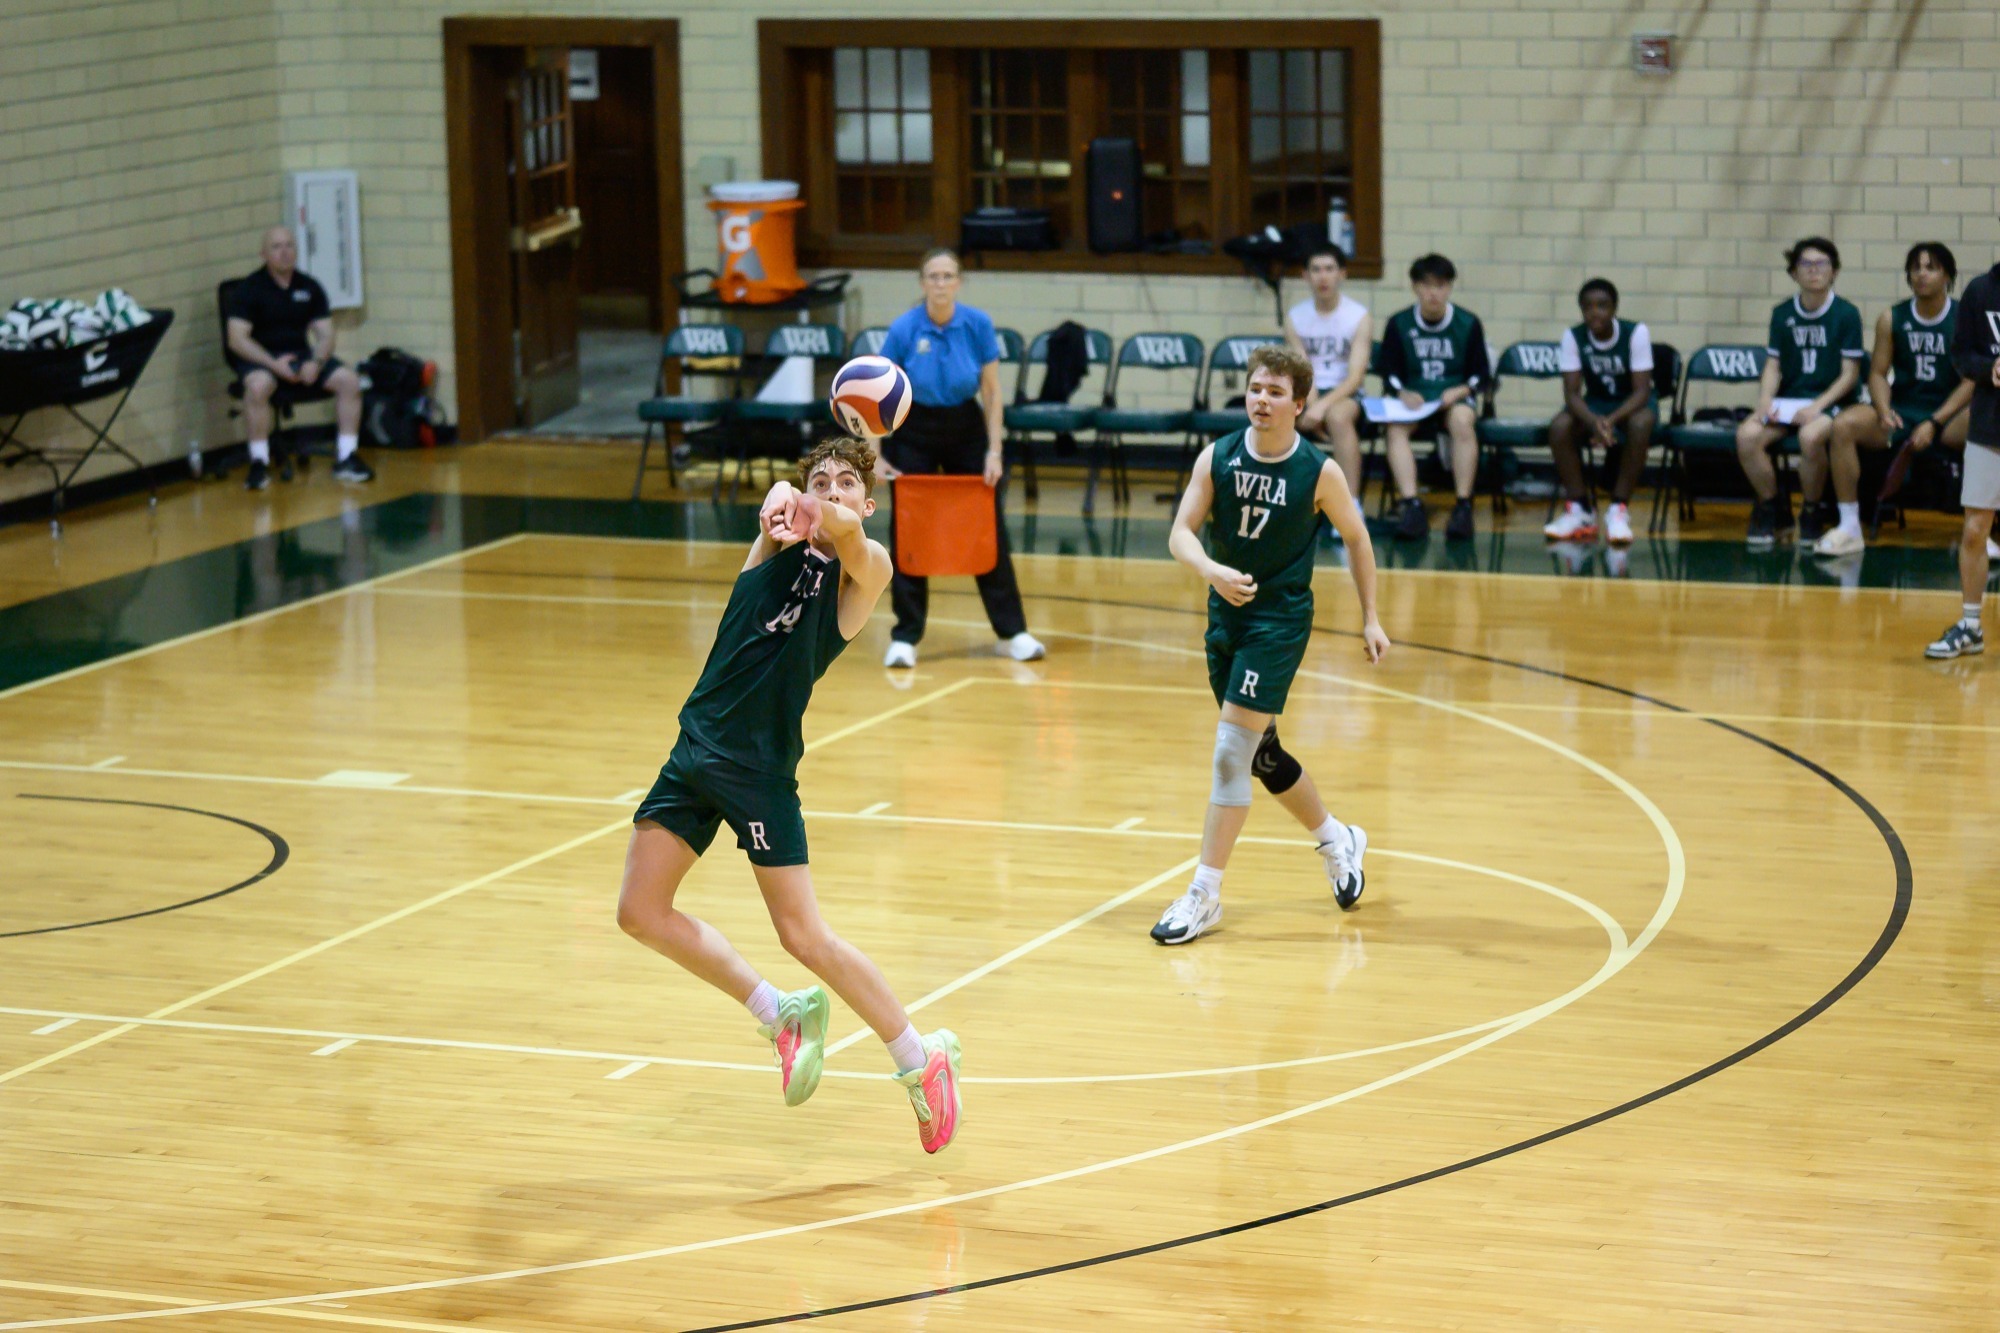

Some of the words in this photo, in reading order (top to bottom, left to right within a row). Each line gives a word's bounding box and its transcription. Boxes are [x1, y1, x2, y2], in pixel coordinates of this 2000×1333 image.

[722, 215, 751, 253] G
[682, 327, 729, 354] WRA
[781, 327, 831, 355] WRA
[1136, 336, 1188, 364] WRA
[1413, 337, 1455, 360] WRA
[1792, 325, 1827, 348] WRA
[1907, 331, 1946, 356] WRA
[1707, 348, 1760, 377] WRA
[1915, 354, 1937, 382] 15
[1234, 470, 1287, 506] WRA
[1237, 505, 1271, 540] 17
[1239, 669, 1260, 698] R
[748, 821, 771, 850] R
